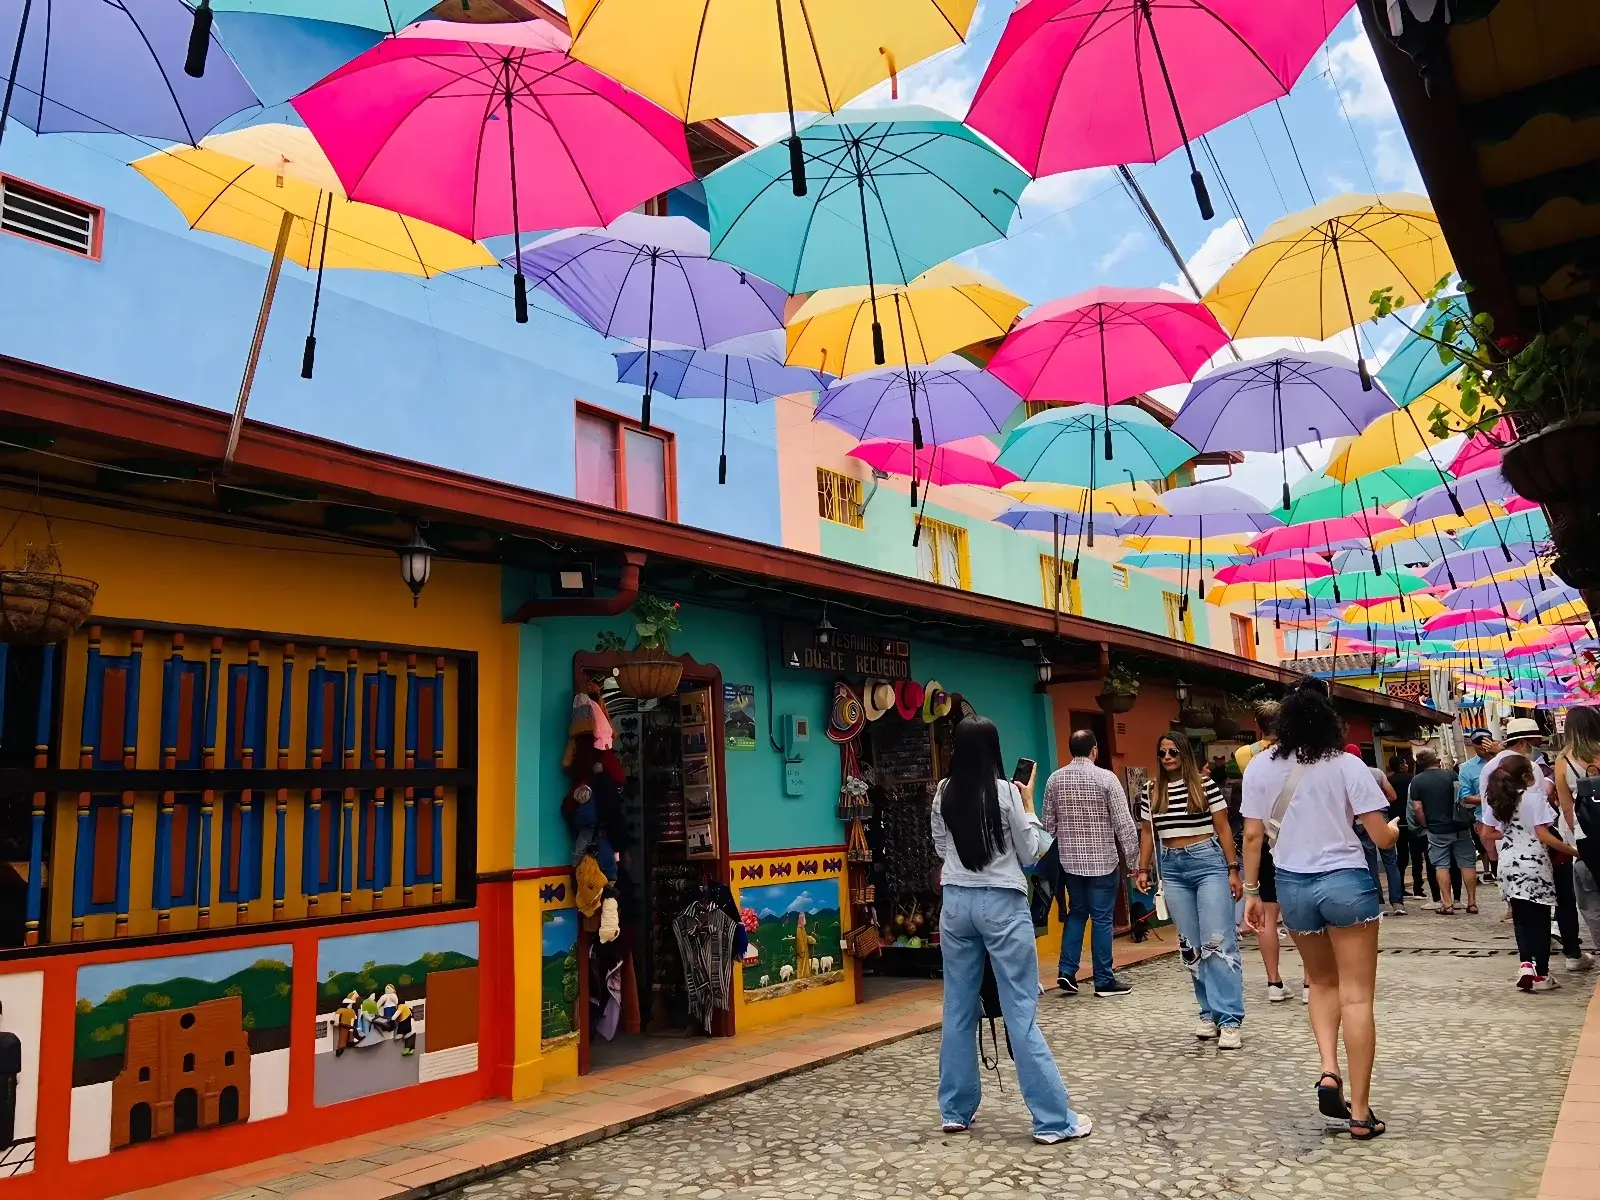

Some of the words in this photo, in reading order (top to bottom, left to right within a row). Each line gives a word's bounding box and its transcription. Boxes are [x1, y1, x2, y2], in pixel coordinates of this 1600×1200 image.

[815, 631, 880, 653] TESANIAS
[804, 647, 845, 671] DUCE
[856, 654, 908, 678] RECUERDO
